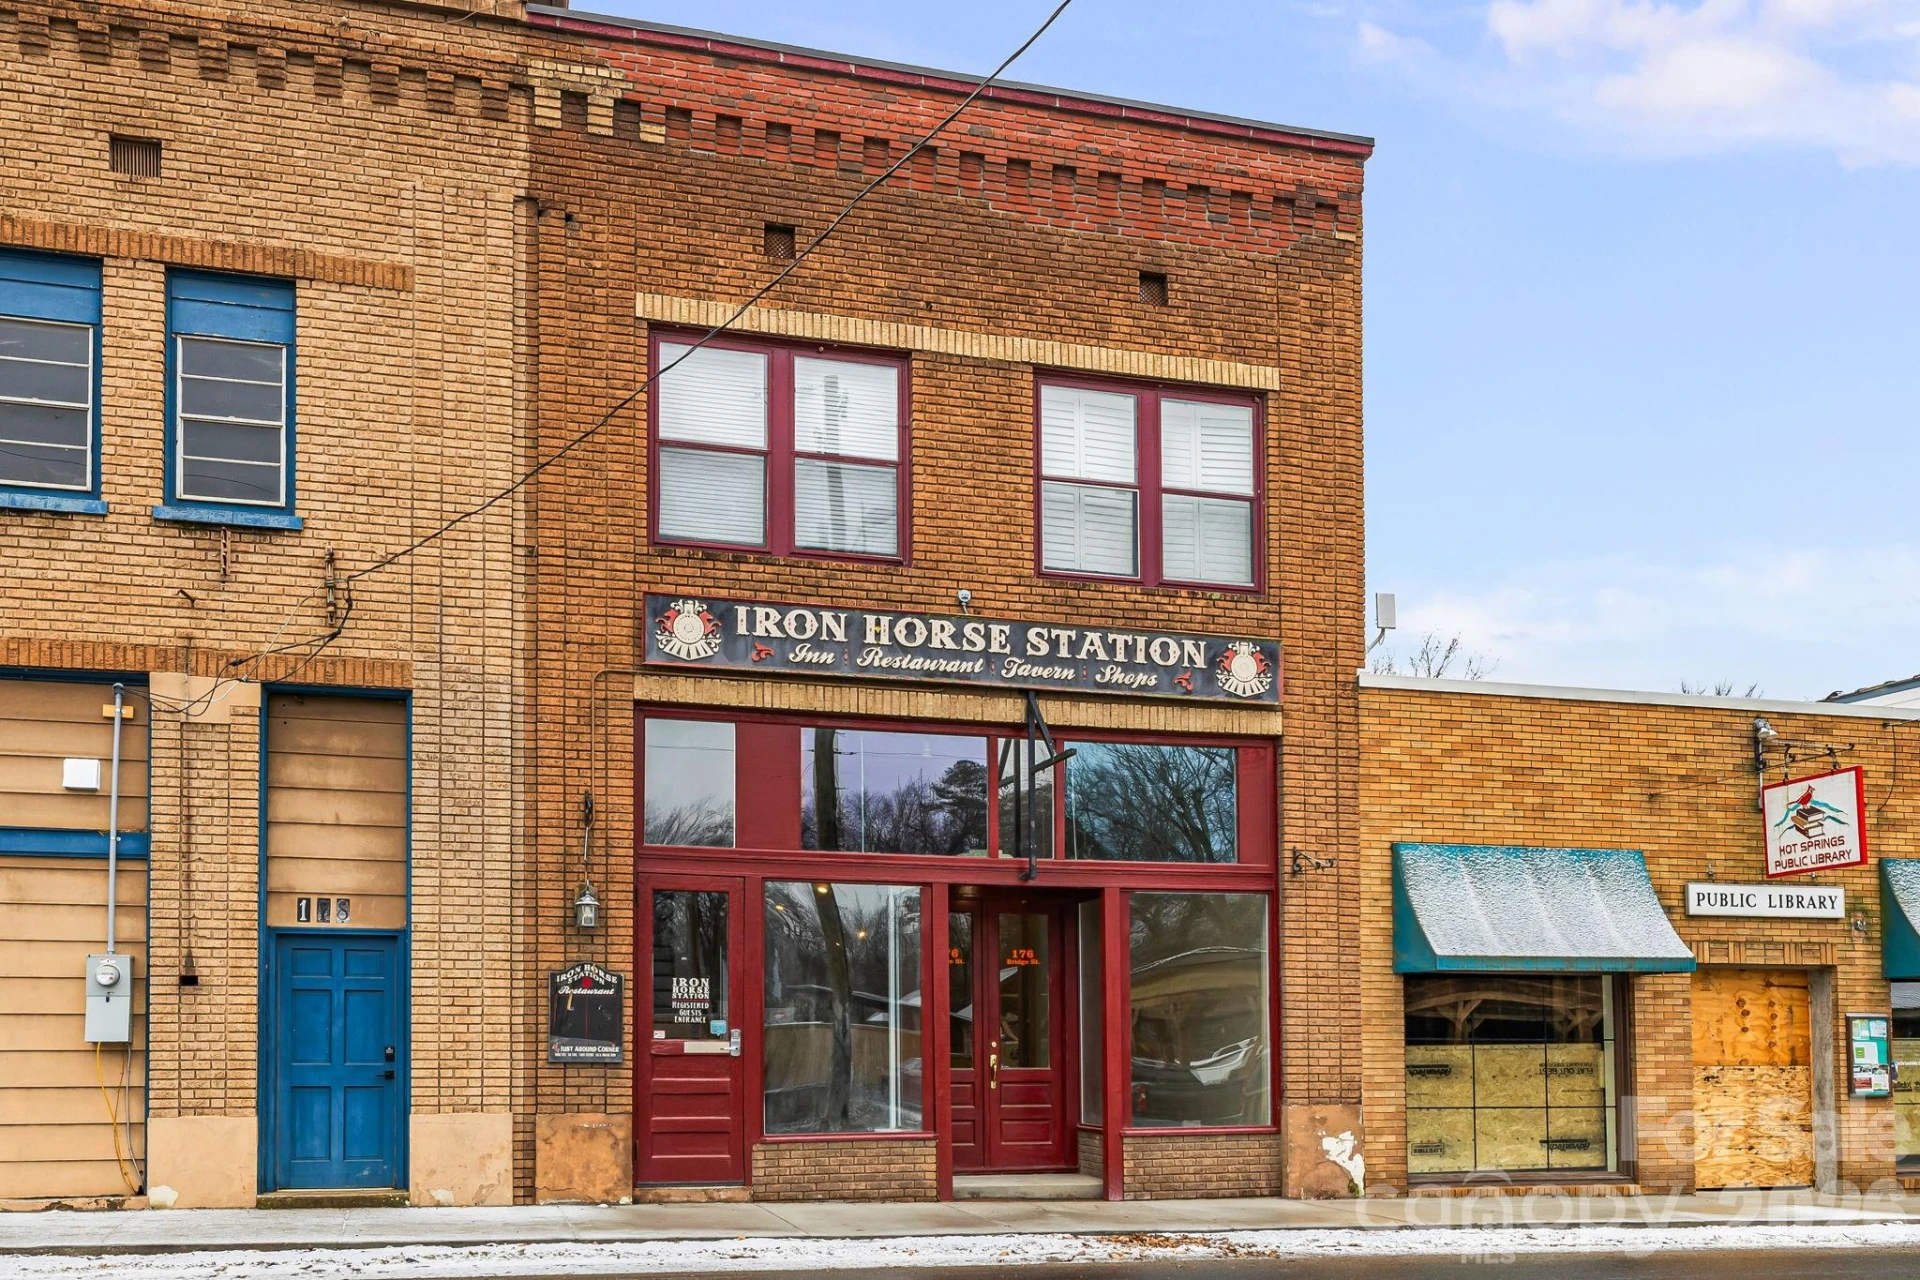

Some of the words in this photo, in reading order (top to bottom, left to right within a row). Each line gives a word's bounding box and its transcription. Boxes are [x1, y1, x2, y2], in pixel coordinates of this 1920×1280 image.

[734, 605, 848, 642] IRON
[863, 614, 1011, 656] HORSE
[1026, 627, 1207, 669] STATION
[789, 643, 835, 664] Inn
[857, 647, 983, 675] Restaurant
[1001, 657, 1076, 680] Tavern
[1095, 665, 1158, 687] Shops
[1779, 842, 1798, 855] HOT
[1800, 835, 1845, 853] SPRINGS
[1774, 857, 1808, 871] PUBLIC
[1810, 849, 1852, 865] LIBRARY
[1696, 892, 1757, 908] PUBLIC
[1768, 894, 1838, 910] LIBRARY
[949, 948, 959, 958] 6
[1012, 949, 1034, 958] 176
[556, 966, 582, 982] IRON
[584, 964, 618, 984] HORSE
[567, 971, 605, 985] STATION
[672, 977, 710, 987] IRON
[558, 985, 615, 995] Restaurant
[672, 986, 710, 994] HORSE
